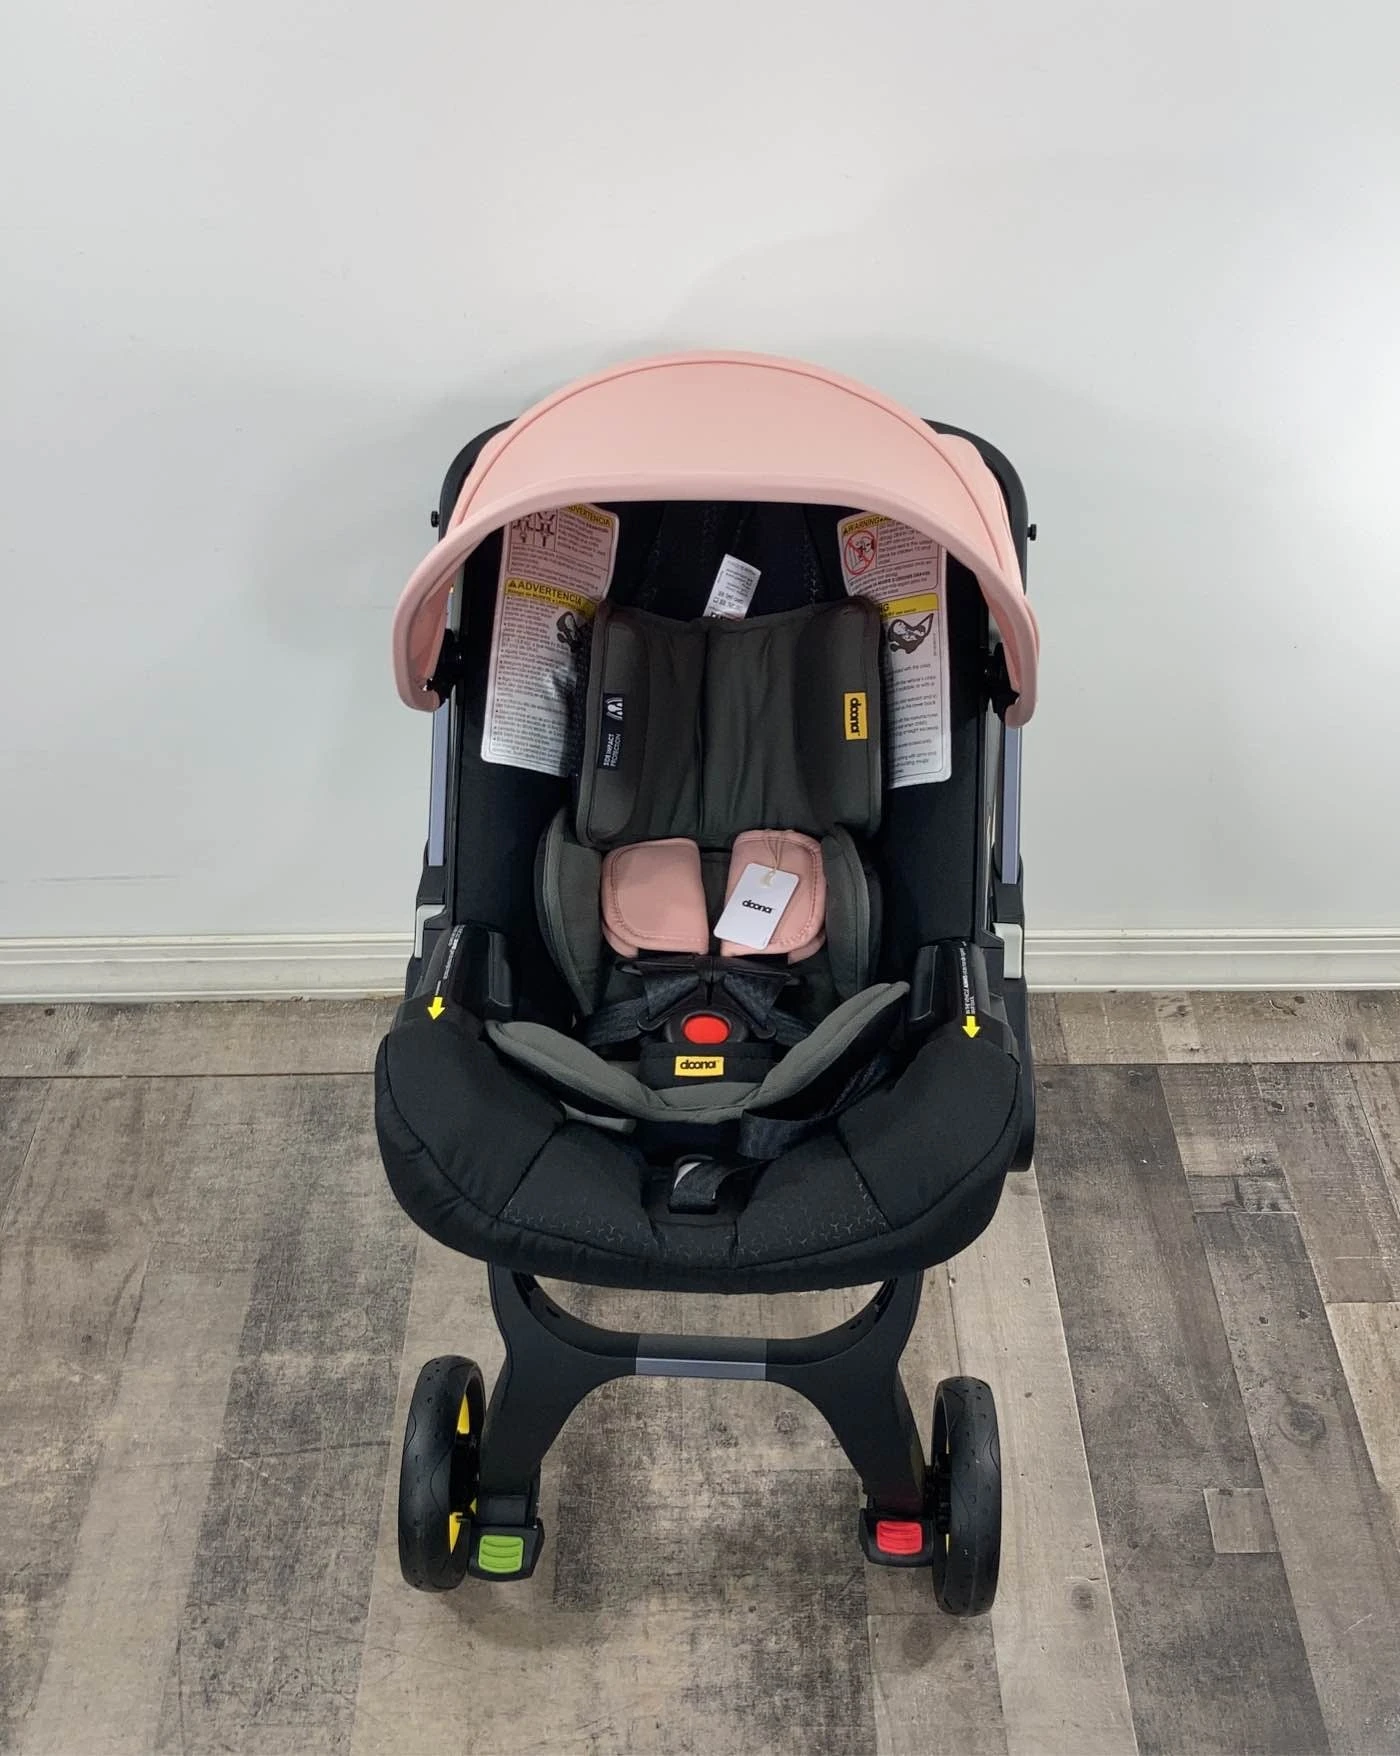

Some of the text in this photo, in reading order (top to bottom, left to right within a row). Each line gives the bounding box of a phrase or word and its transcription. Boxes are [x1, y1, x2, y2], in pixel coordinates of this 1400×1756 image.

[518, 581, 582, 605] ADVERTENCIA
[850, 698, 862, 733] doona
[742, 899, 773, 914] doona
[680, 1060, 716, 1070] doona
